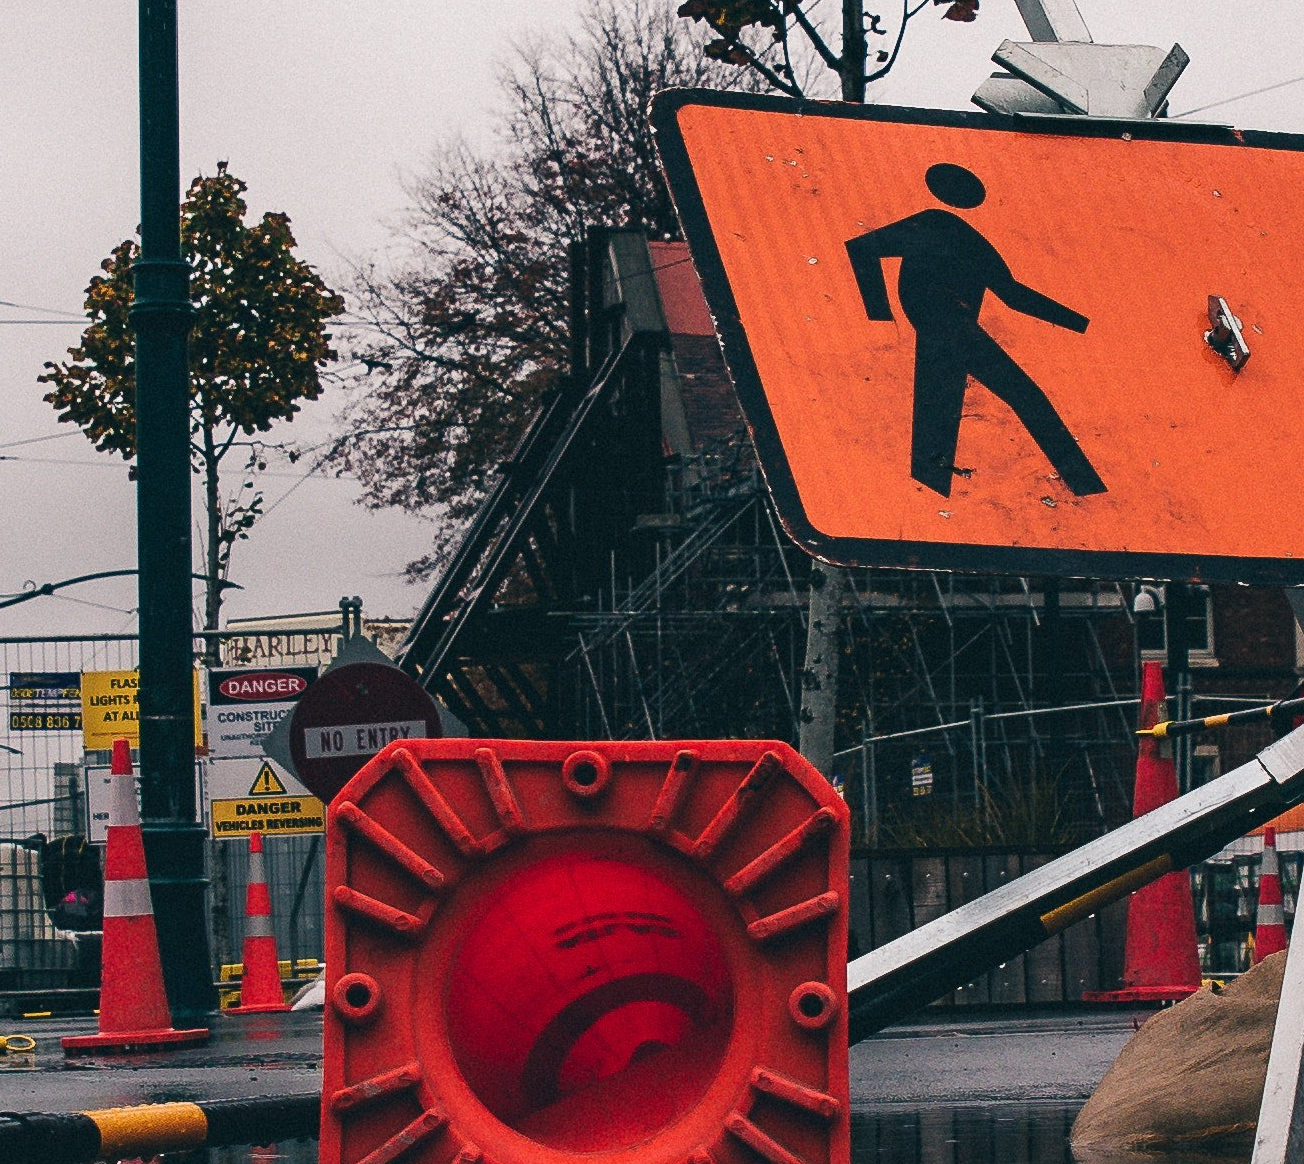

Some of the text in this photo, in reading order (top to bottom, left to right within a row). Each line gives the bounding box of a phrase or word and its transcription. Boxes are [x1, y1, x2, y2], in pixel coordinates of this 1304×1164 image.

[110, 678, 139, 689] FLAS
[228, 678, 300, 694] DANGER
[89, 695, 131, 706] LIGHTS
[103, 711, 118, 722] AT
[320, 730, 344, 753] NO
[236, 801, 301, 815] DANGER
[216, 816, 323, 832] VEHICLES REVERSING
